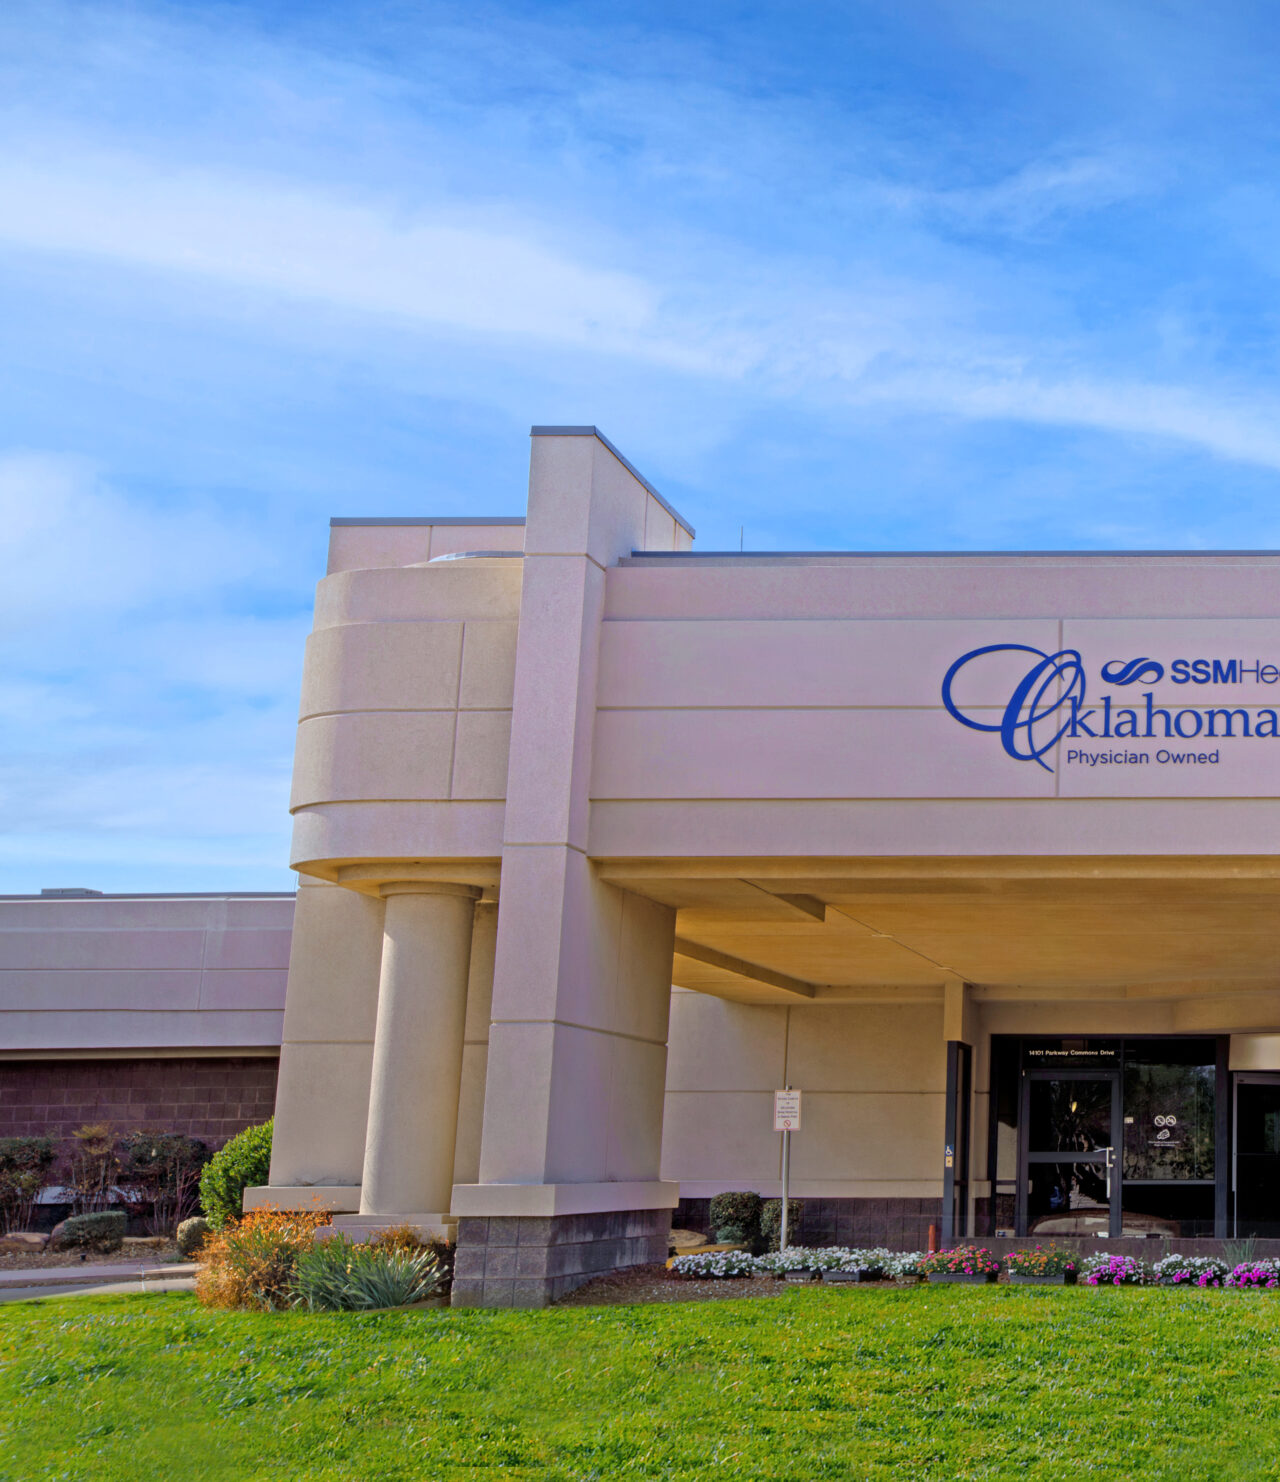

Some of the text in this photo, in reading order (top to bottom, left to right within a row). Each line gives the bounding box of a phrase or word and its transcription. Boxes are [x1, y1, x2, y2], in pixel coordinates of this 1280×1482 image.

[942, 644, 1280, 773] Oklahoma
[1067, 749, 1220, 766] Physician Owned
